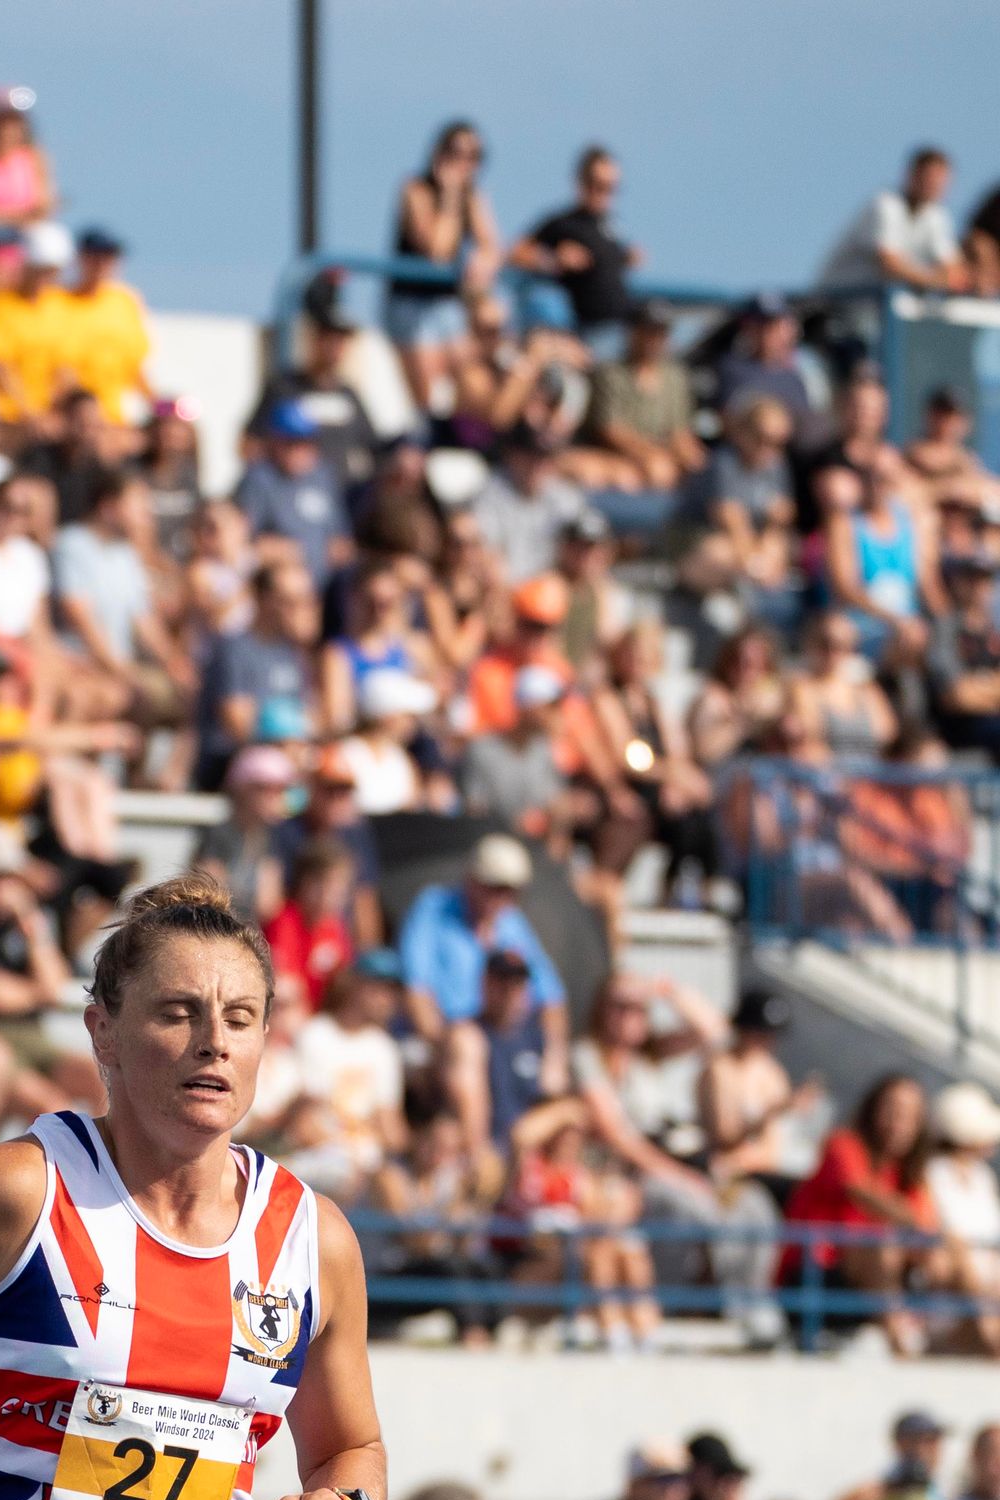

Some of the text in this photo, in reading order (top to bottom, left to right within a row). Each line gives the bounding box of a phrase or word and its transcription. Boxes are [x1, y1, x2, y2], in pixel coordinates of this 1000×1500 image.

[59, 1293, 140, 1311] RONHILL
[131, 1401, 241, 1431] Beer Mile World Classic
[155, 1420, 216, 1441] Windsor 2024
